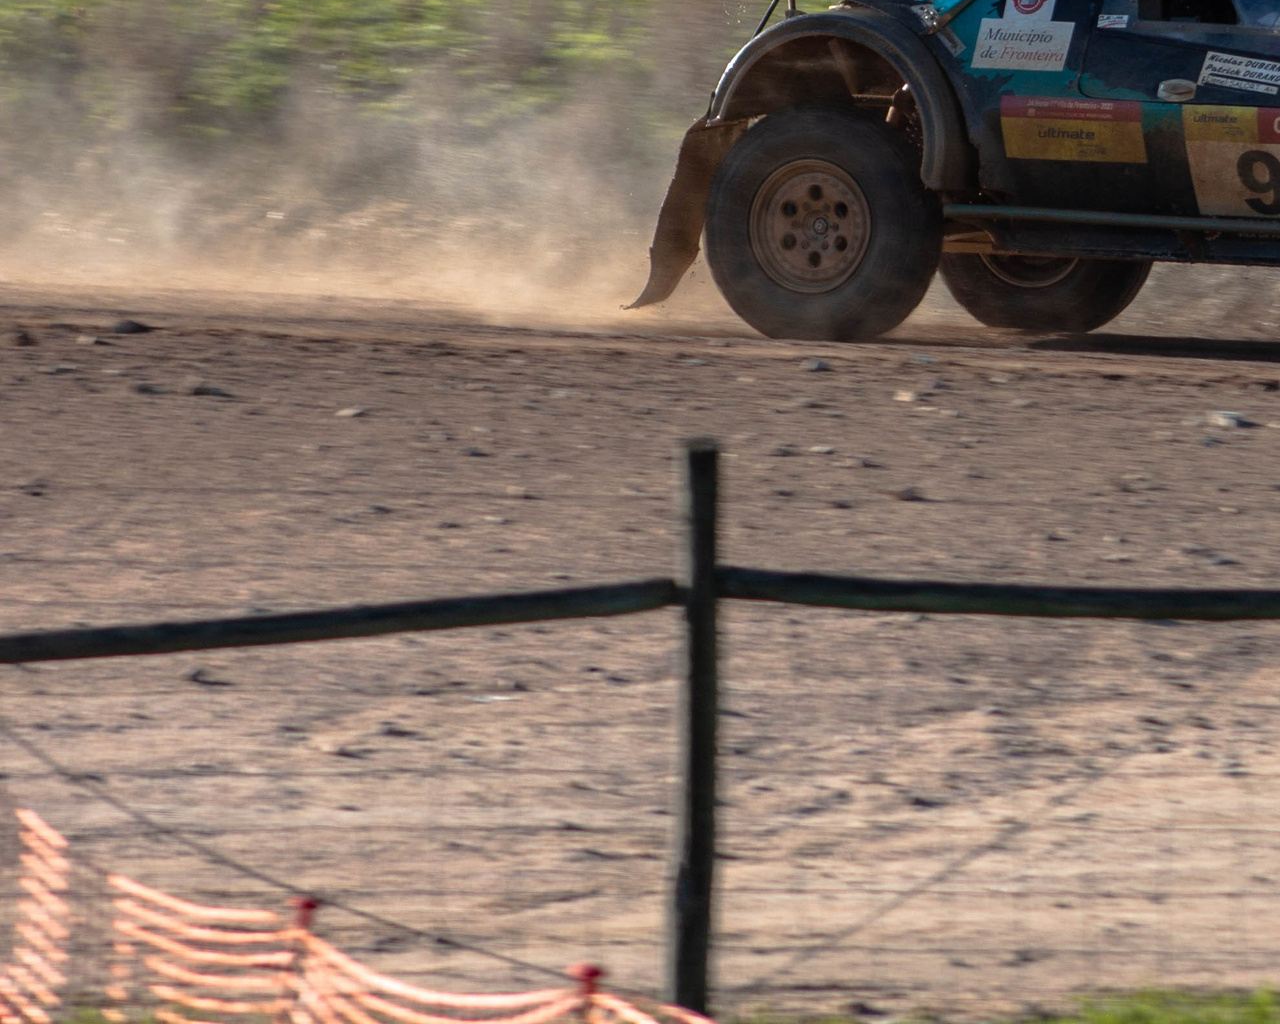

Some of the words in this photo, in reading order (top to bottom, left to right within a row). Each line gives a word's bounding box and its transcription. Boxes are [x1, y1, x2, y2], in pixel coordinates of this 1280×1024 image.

[980, 46, 998, 59] de
[1000, 47, 1064, 62] Fronteira
[1208, 54, 1243, 67] Nicolas
[1205, 63, 1241, 77] Patrick
[1038, 128, 1095, 140] ultimate
